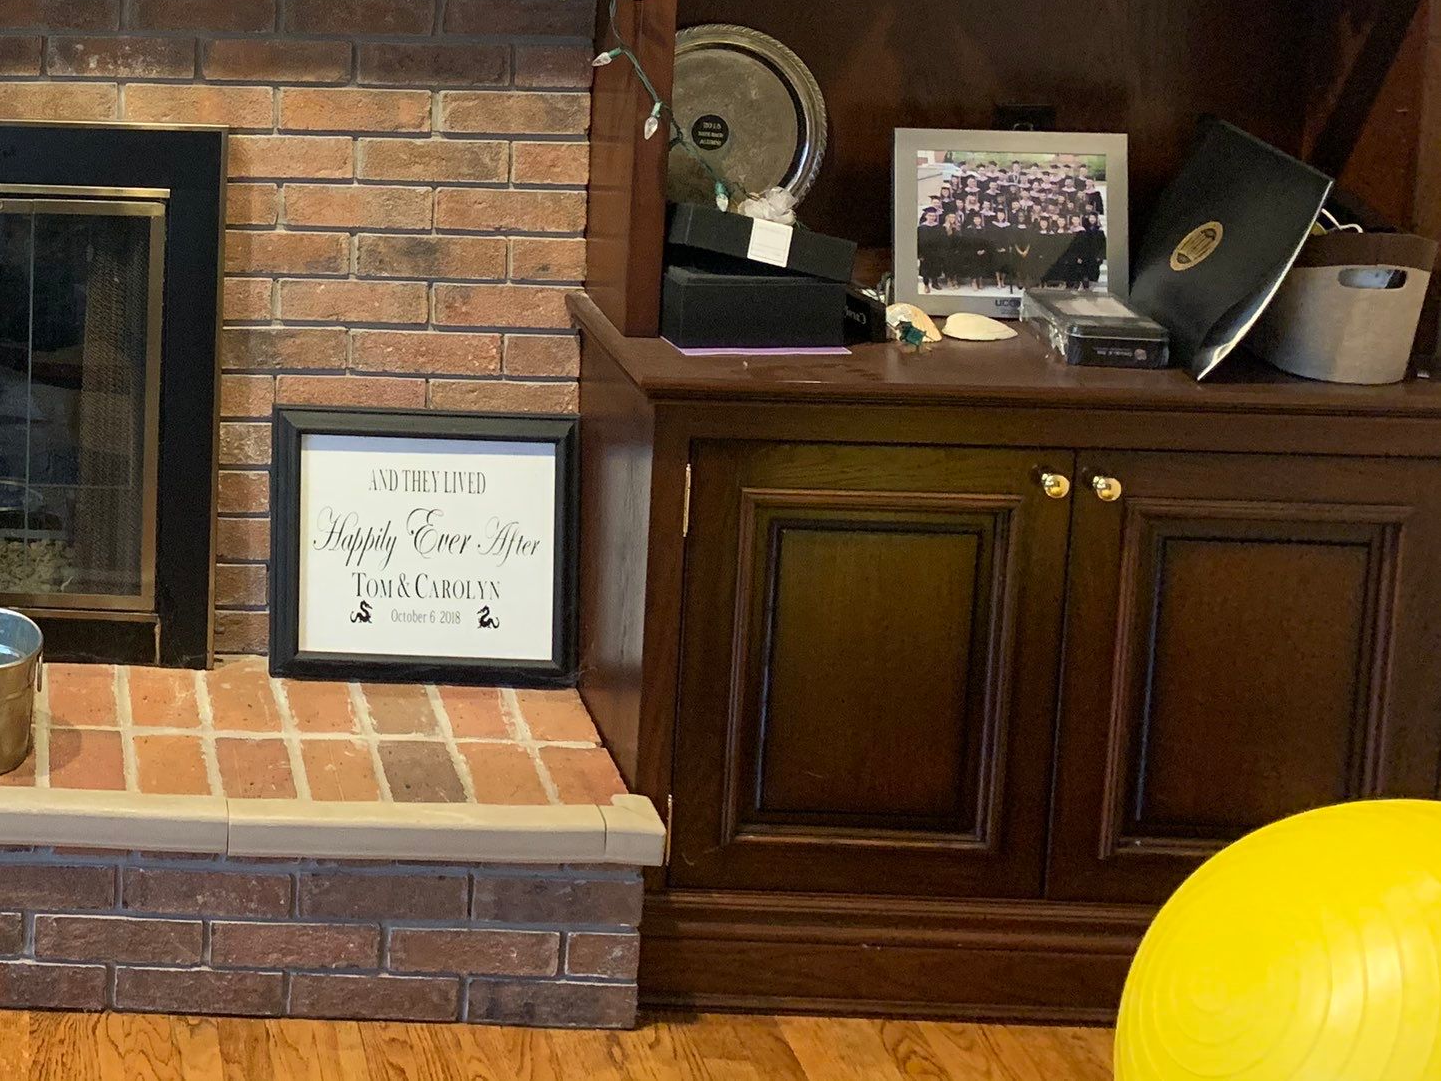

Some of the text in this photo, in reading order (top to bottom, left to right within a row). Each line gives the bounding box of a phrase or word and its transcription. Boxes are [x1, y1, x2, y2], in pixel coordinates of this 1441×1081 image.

[368, 469, 486, 495] AND THEY LIVED
[313, 506, 540, 569] Happily Ever After
[391, 608, 461, 625] October 6 2018
